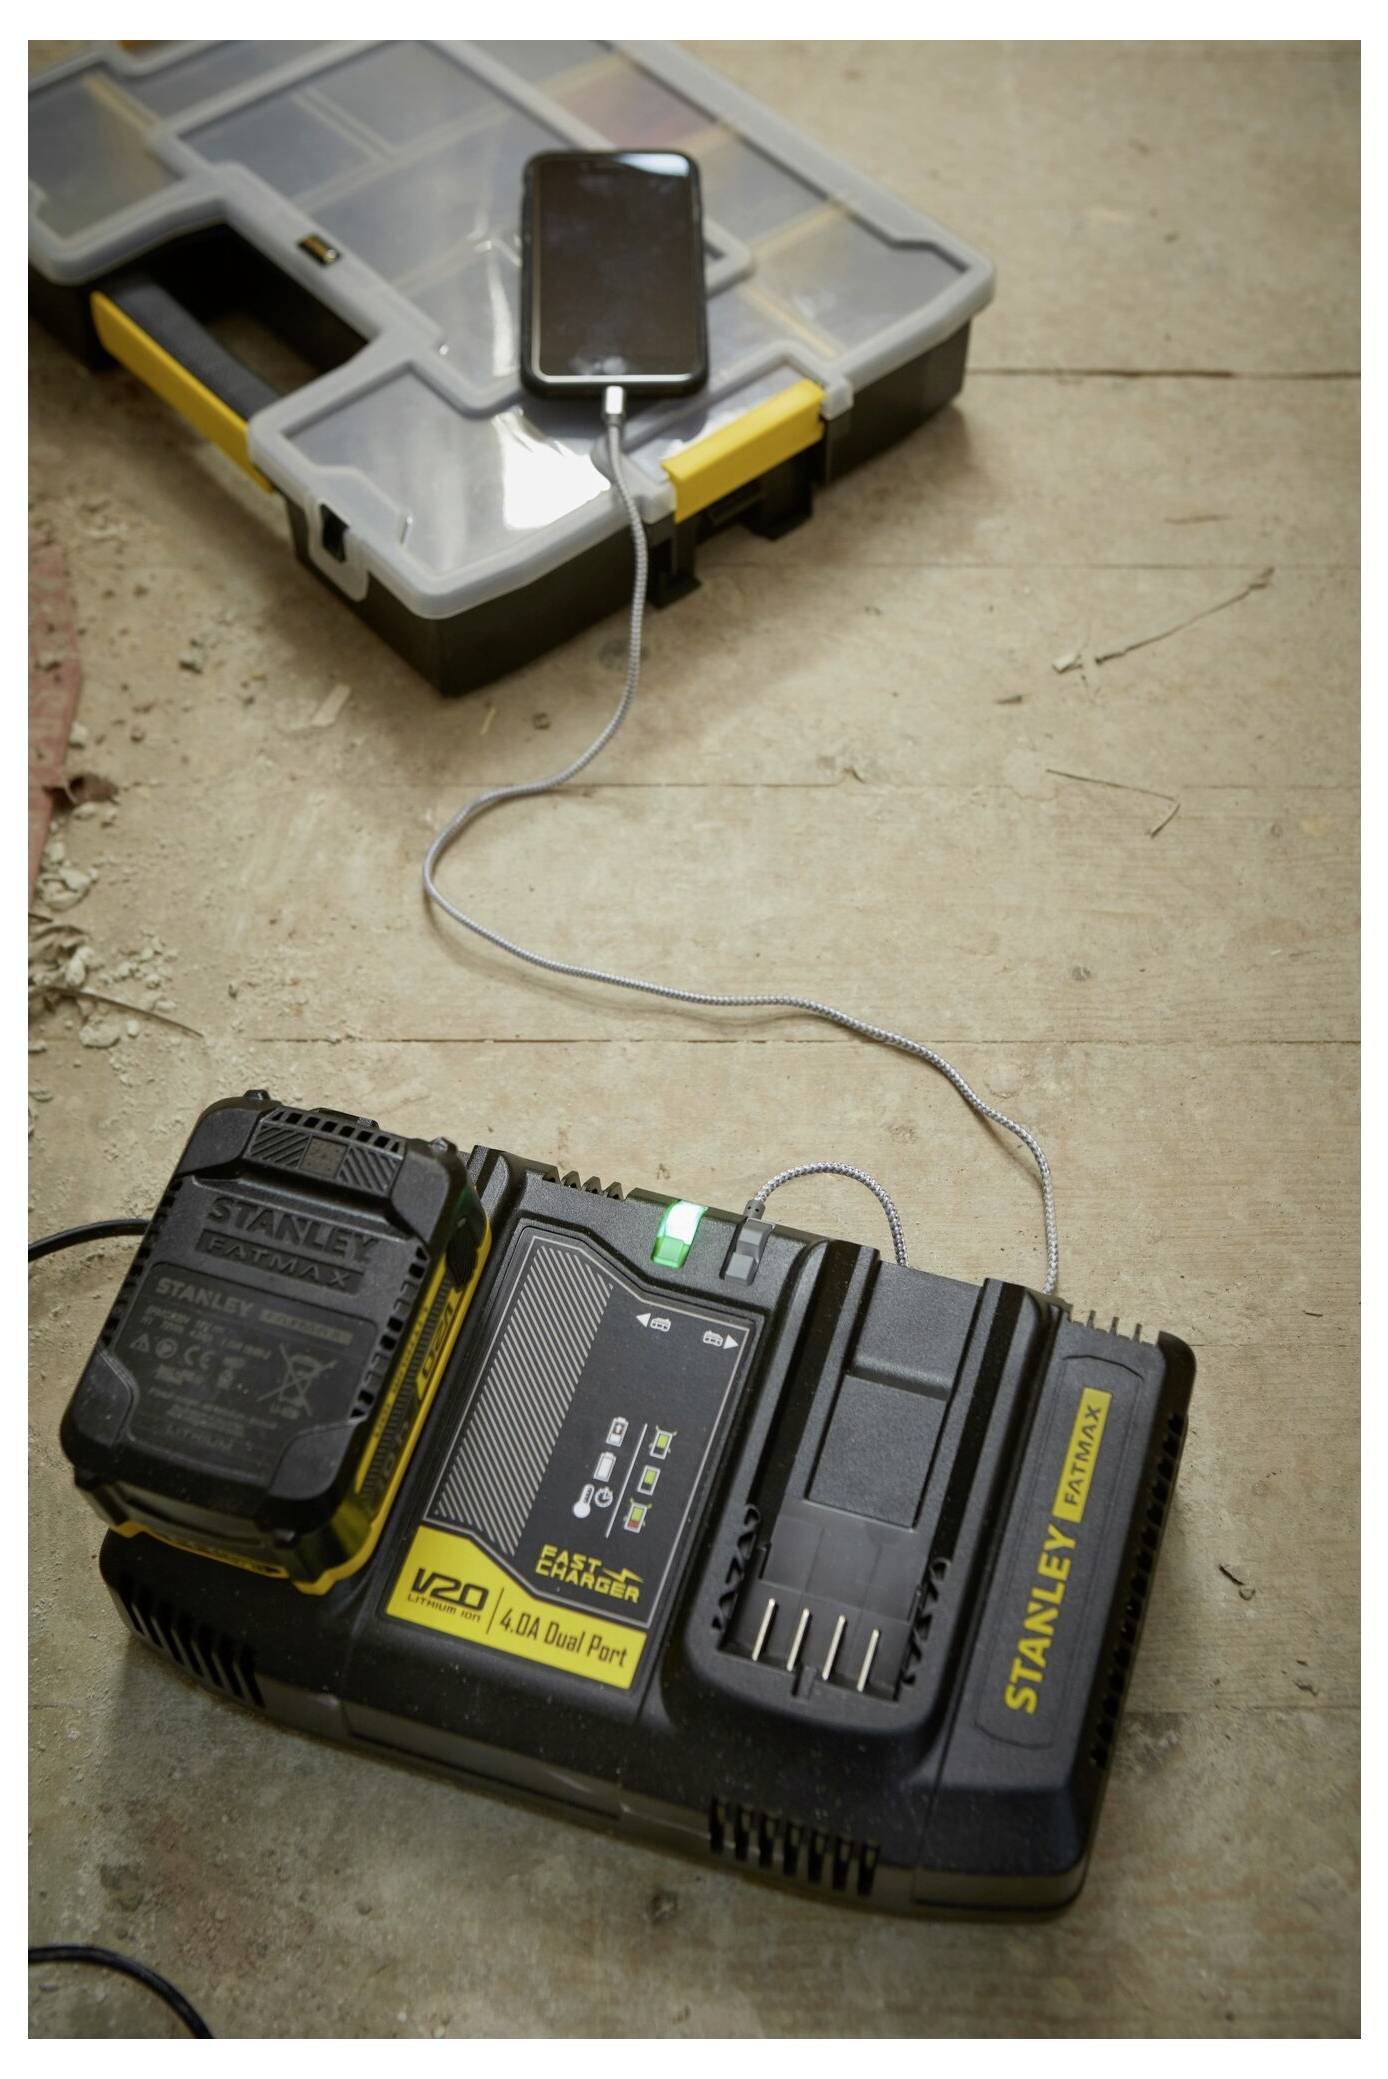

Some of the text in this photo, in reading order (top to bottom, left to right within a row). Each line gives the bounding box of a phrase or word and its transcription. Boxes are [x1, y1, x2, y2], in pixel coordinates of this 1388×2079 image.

[207, 1196, 378, 1263] STANLEY
[207, 1237, 350, 1289] FATMAX
[155, 1277, 254, 1319] STANLEY
[535, 1559, 640, 1604] CHARGER
[540, 1544, 602, 1572] FAST
[1004, 1404, 1101, 1715] STANLEY FATMAX
[410, 1567, 489, 1612] V20
[499, 1608, 628, 1667] 4.0A Dual Port
